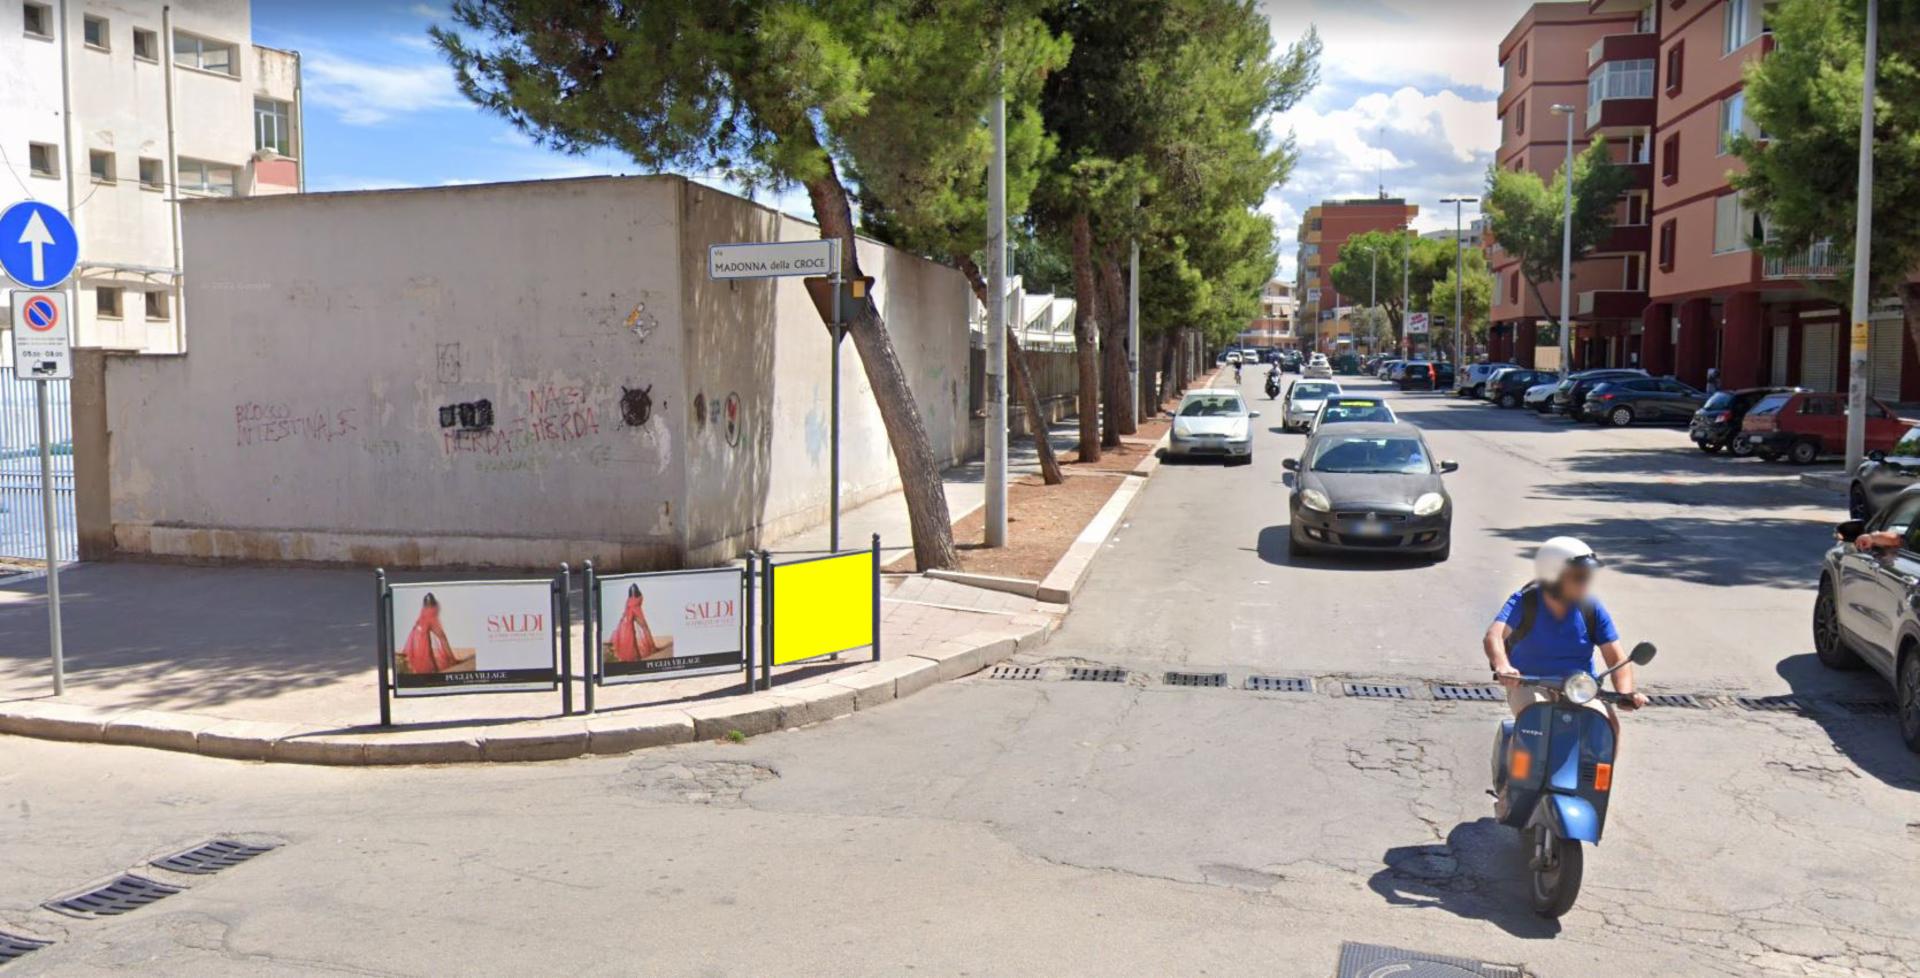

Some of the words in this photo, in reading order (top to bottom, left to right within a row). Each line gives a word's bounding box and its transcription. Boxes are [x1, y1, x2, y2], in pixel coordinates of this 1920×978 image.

[715, 262, 767, 272] MADONNA
[770, 260, 790, 270] della
[794, 258, 825, 269] CROCE
[532, 406, 600, 441] MERDA
[685, 600, 734, 619] SALDI
[487, 614, 543, 632] SALDI
[672, 657, 700, 666] VILLAGE
[445, 673, 474, 681] PUGLIA
[475, 671, 507, 680] VILLAGE
